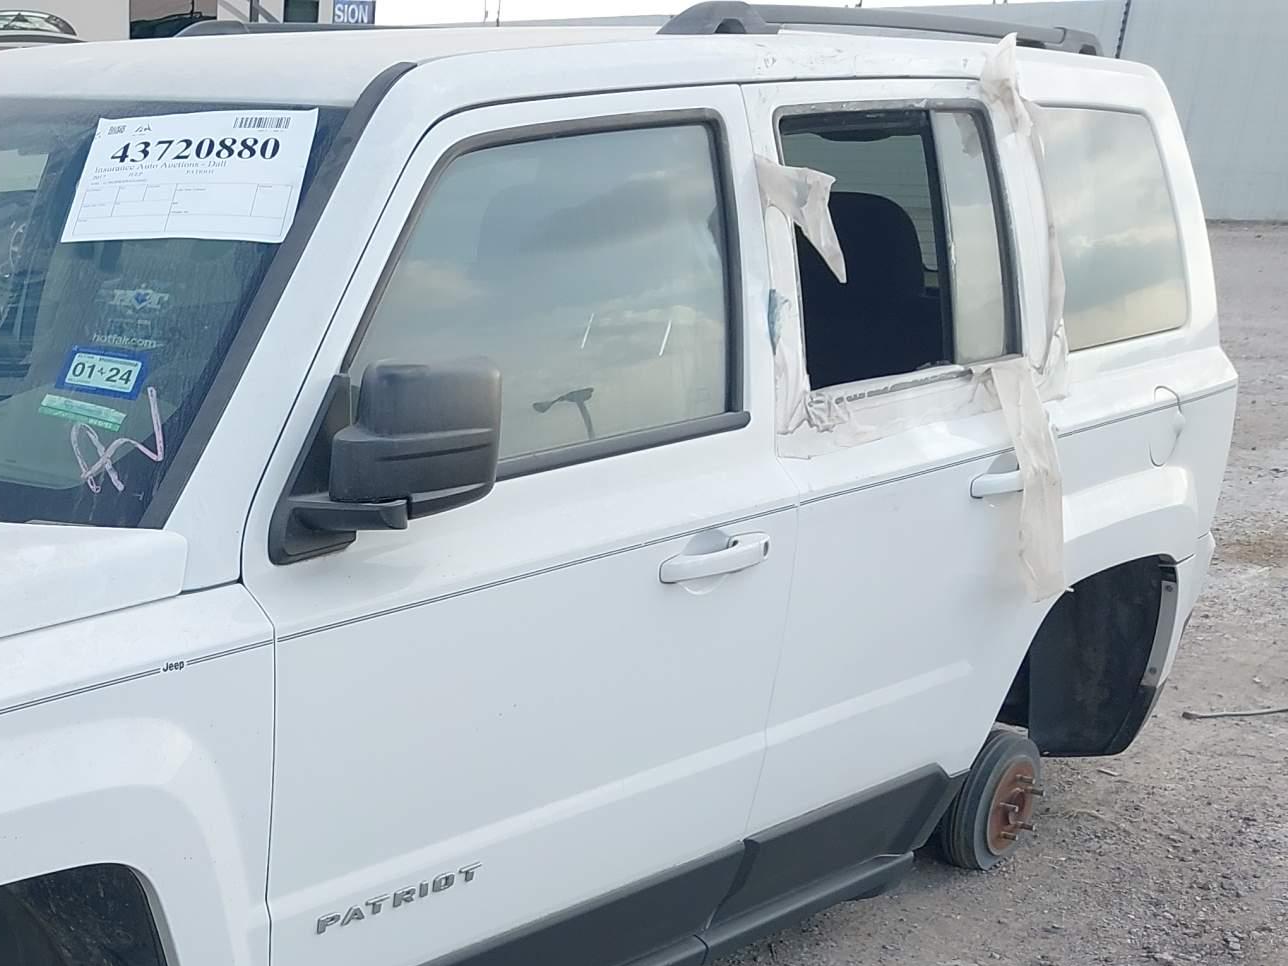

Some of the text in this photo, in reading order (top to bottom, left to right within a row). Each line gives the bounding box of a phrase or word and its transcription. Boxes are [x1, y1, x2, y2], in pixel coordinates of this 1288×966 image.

[334, 3, 369, 24] SION
[111, 137, 281, 163] 43720880
[94, 165, 136, 173] Insurance
[137, 162, 158, 170] Auto
[160, 160, 199, 169] Auctions
[162, 660, 185, 672] Jeep
[316, 862, 482, 935] PATRIOT
